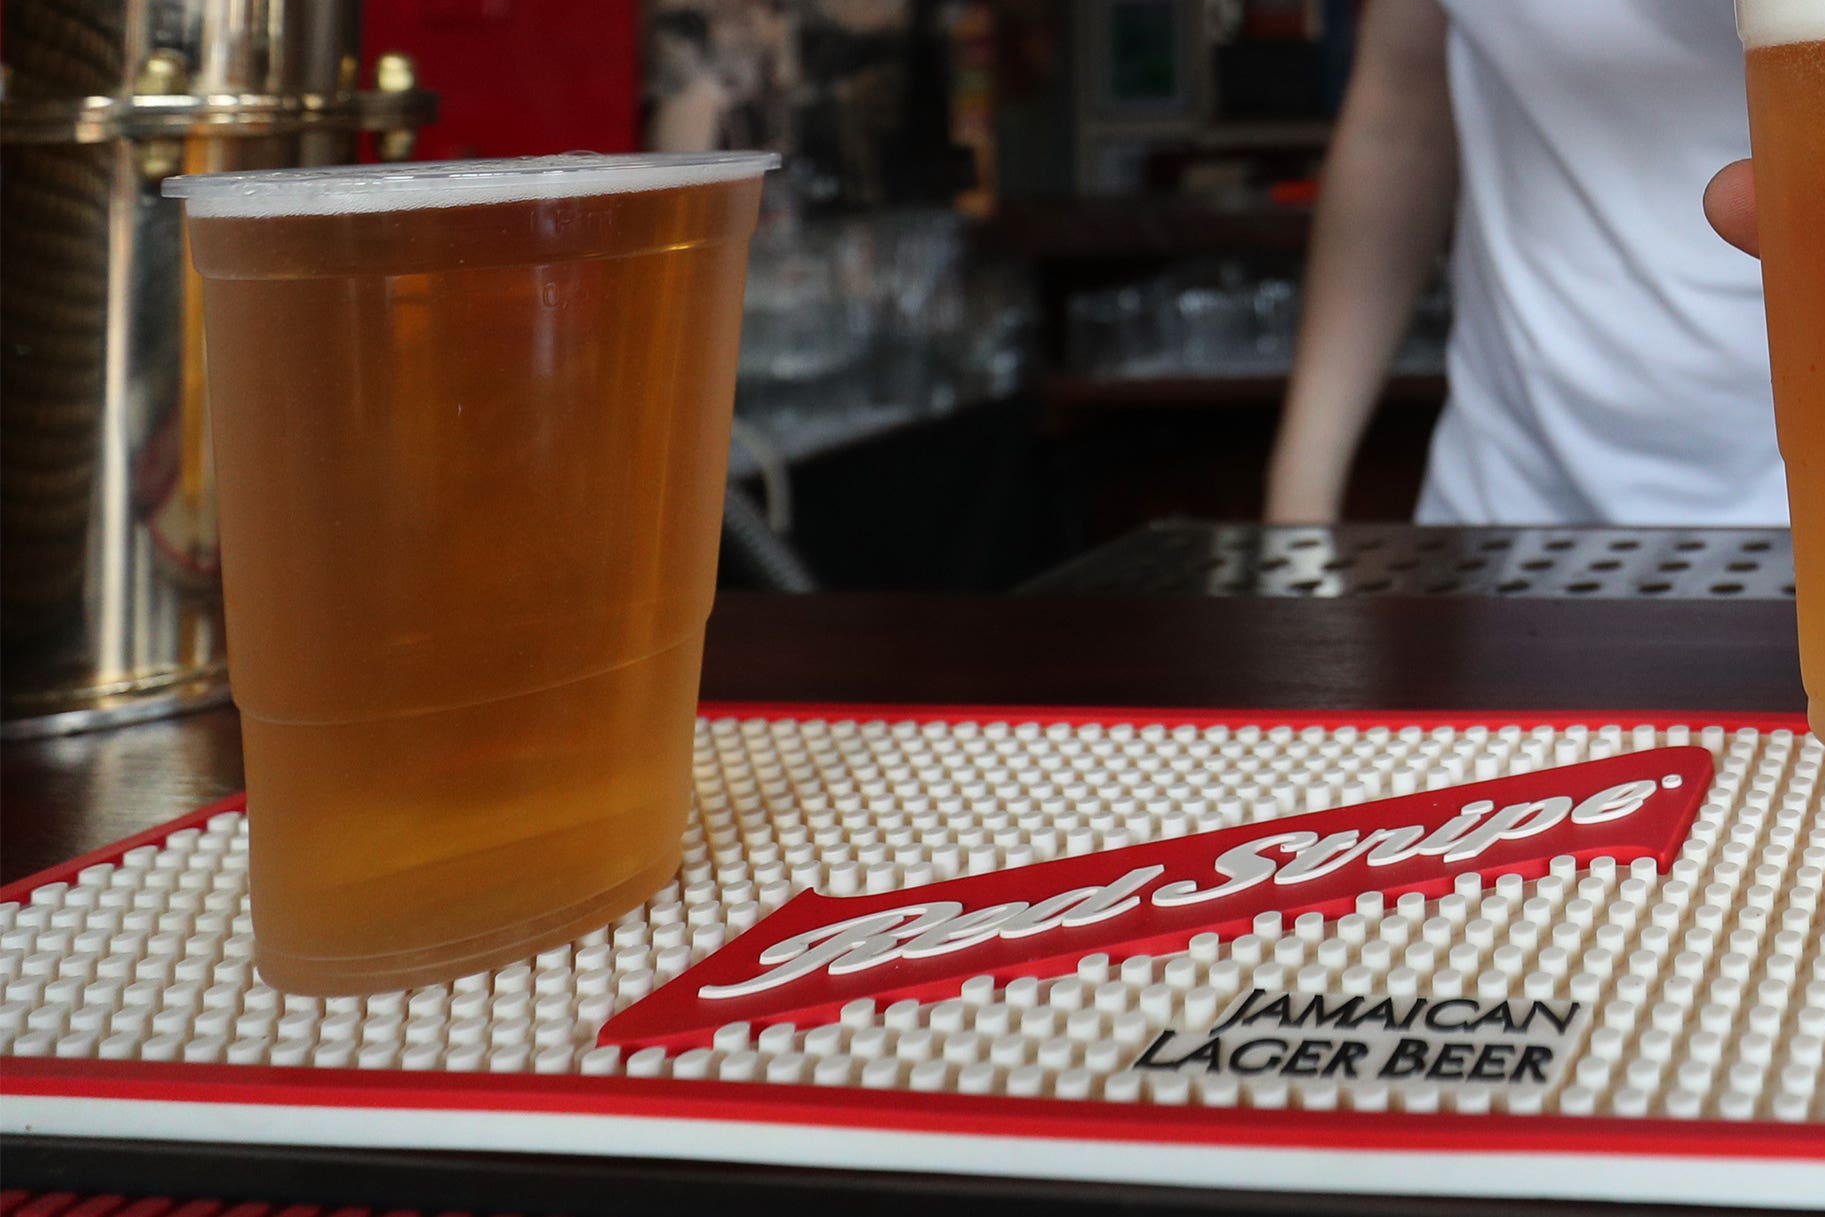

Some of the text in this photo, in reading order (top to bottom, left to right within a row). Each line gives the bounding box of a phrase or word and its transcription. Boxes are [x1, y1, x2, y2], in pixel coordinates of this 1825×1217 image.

[697, 780, 1658, 998] Red Stripe
[1208, 988, 1580, 1036] JAMAICAN
[1133, 1029, 1554, 1083] LAGER BEER
